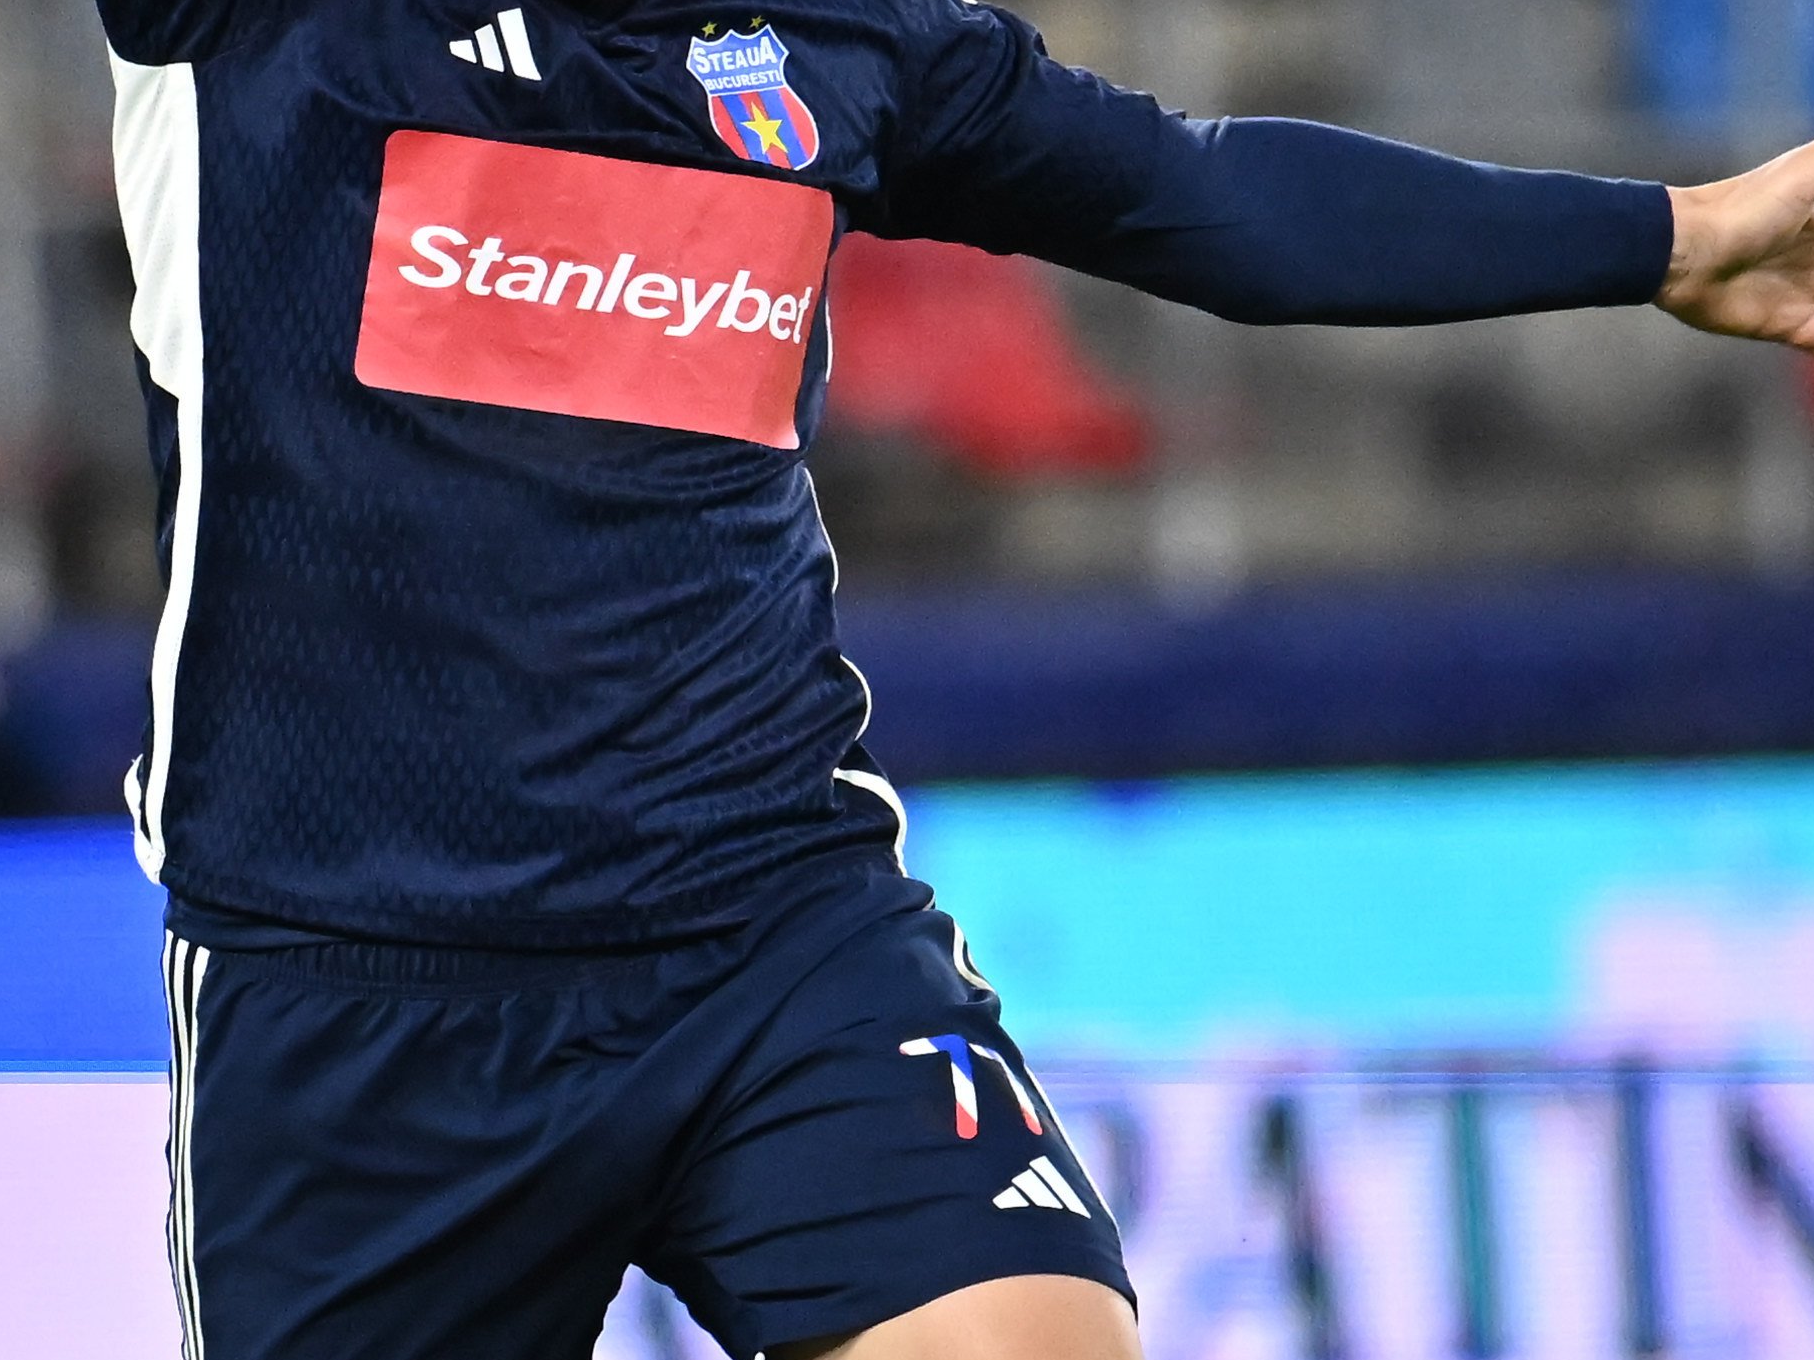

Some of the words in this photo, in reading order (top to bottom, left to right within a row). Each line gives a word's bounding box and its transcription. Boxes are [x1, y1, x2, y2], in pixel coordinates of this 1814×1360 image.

[705, 70, 782, 90] BUCURESTI
[399, 225, 813, 345] Stanleybet
[898, 1033, 1043, 1140] 77
